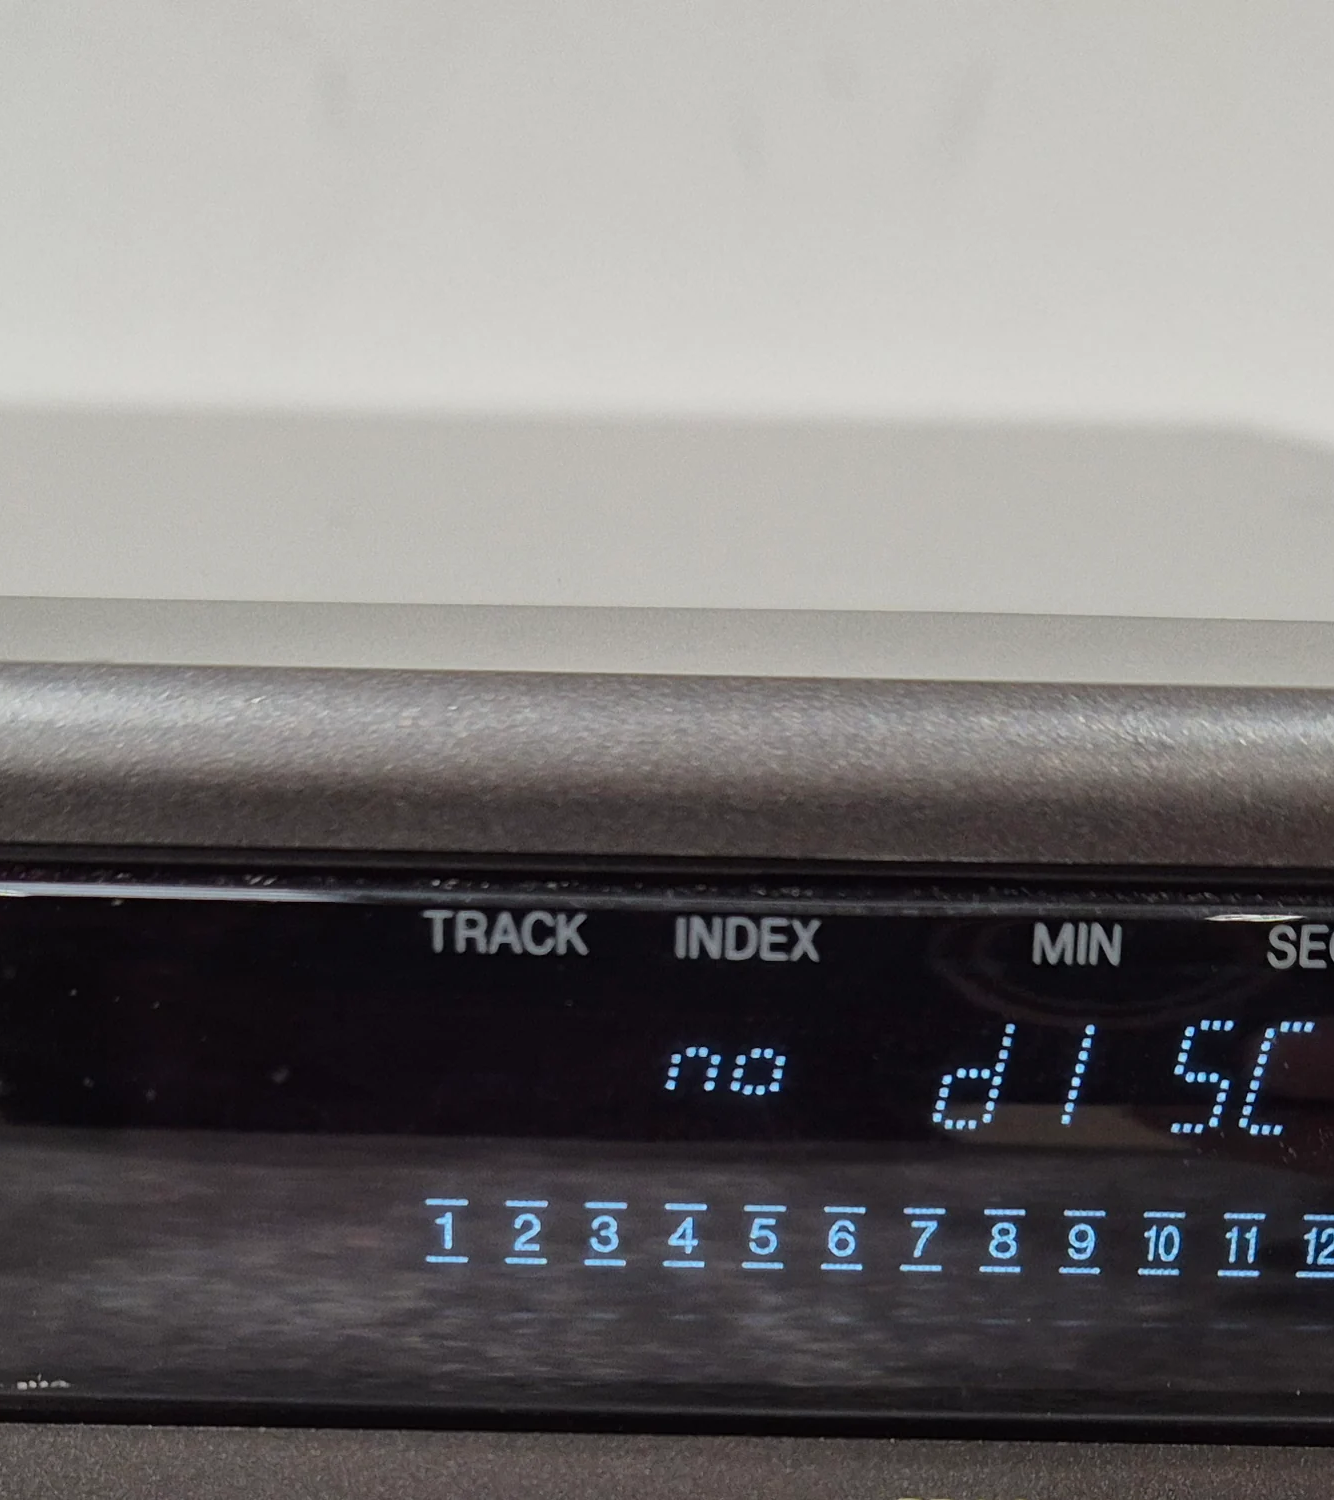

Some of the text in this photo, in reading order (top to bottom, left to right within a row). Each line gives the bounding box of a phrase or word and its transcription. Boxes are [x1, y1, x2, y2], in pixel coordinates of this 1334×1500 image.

[422, 909, 589, 956] TRACK
[675, 915, 821, 962] INDEX
[1032, 922, 1122, 967] MIN
[664, 1046, 787, 1096] no
[435, 1211, 453, 1250] 1
[513, 1212, 541, 1252] 2
[589, 1214, 620, 1254] 3
[667, 1216, 699, 1255] 4
[748, 1217, 778, 1256] 5
[827, 1219, 857, 1258] 6
[911, 1220, 939, 1258] 7
[988, 1221, 1018, 1260] 8
[1067, 1222, 1096, 1261] 9
[1143, 1224, 1181, 1262] 10
[1225, 1225, 1258, 1264] 11
